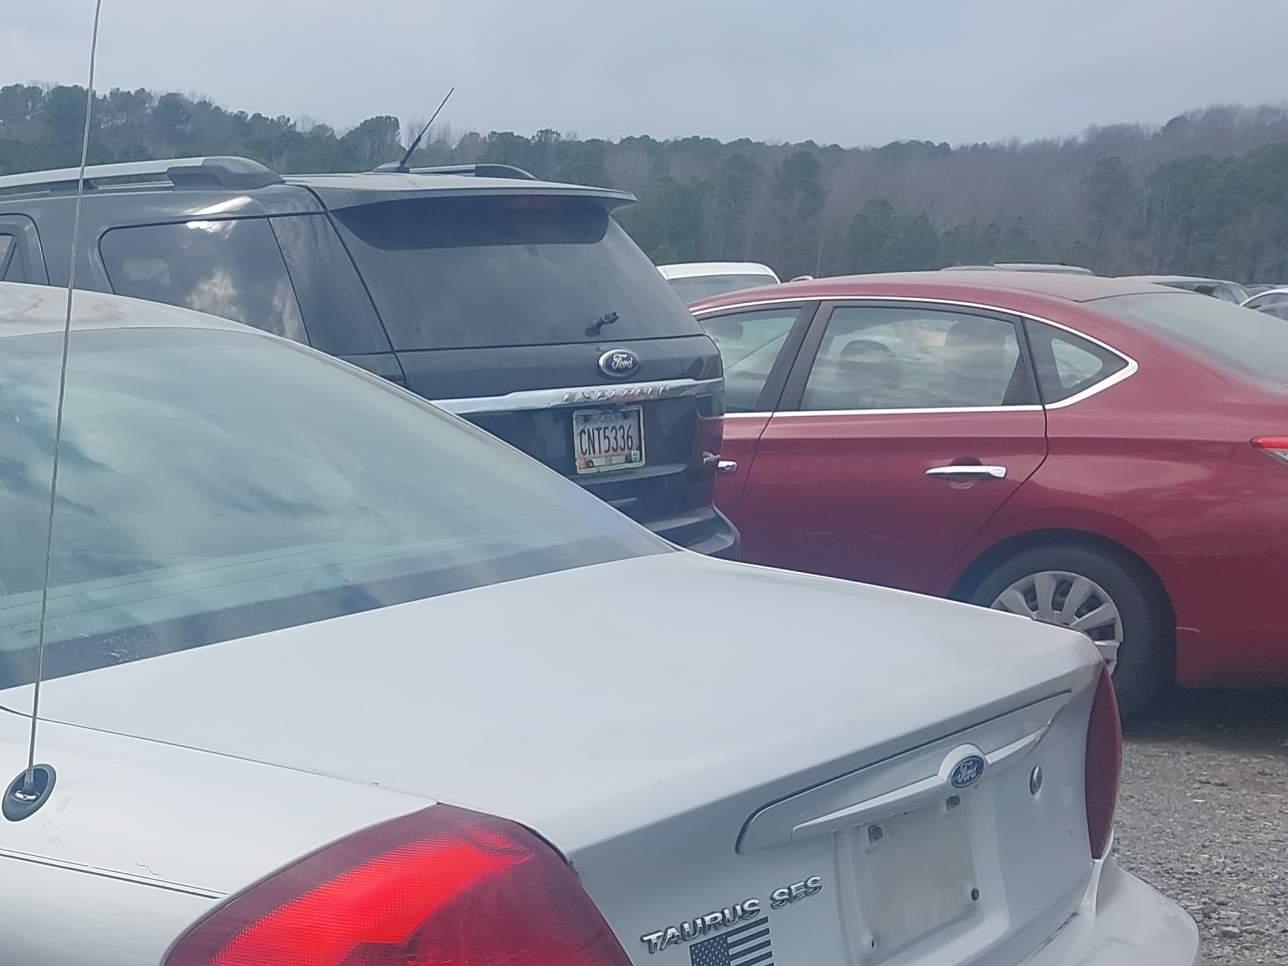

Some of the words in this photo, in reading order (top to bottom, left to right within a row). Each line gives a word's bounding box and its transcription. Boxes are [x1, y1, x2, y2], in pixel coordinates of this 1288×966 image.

[611, 353, 634, 370] Ford
[578, 424, 634, 457] CNT5336
[640, 897, 761, 954] TAURUS
[769, 875, 823, 910] SES
